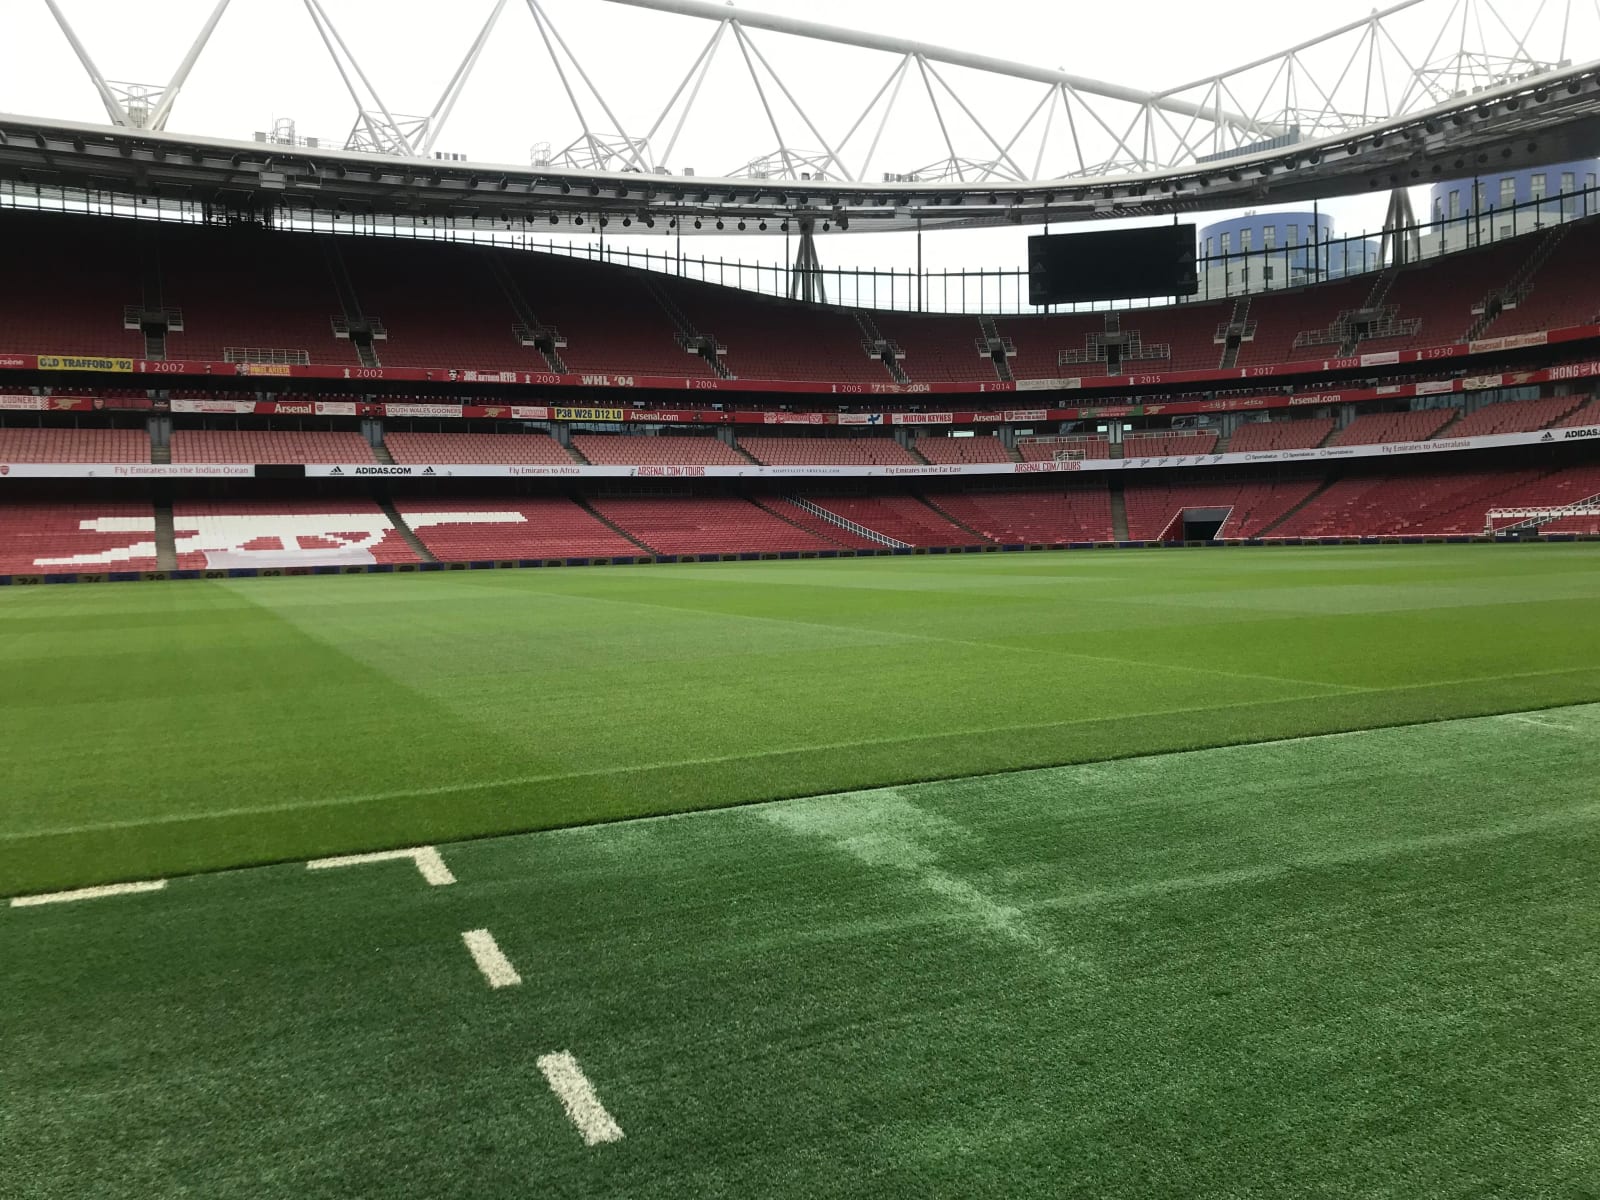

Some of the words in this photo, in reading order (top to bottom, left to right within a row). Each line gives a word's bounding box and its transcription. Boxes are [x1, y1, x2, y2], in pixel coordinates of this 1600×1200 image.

[1428, 348, 1453, 358] 1930
[63, 359, 113, 369] TRAFFORD
[154, 363, 185, 373] 2002
[1336, 359, 1358, 368] 2020
[356, 369, 384, 378] 2002
[1253, 367, 1274, 375] 2017
[1552, 365, 1579, 380] HONG
[536, 375, 561, 384] 2003
[582, 375, 610, 386] WHL
[614, 375, 634, 386] '04
[1141, 376, 1161, 384] 2015
[695, 381, 718, 389] 2004
[906, 384, 930, 392] 2004
[1288, 393, 1341, 405] Arsenal.com
[274, 403, 312, 414] Arsenal
[556, 408, 572, 419] P38
[575, 408, 592, 419] W26
[595, 408, 610, 419] D12
[630, 412, 679, 421] Arsenal.com
[972, 413, 1002, 422] Arsenal
[1382, 445, 1392, 454] Fly
[114, 466, 128, 475] Fly
[130, 466, 167, 474] Emirates
[179, 466, 193, 474] the
[196, 466, 221, 474] Indian
[223, 466, 249, 474] Ocean
[355, 467, 412, 475] ADIDAS.COM
[509, 466, 520, 476] Fly
[559, 466, 580, 474] Africa
